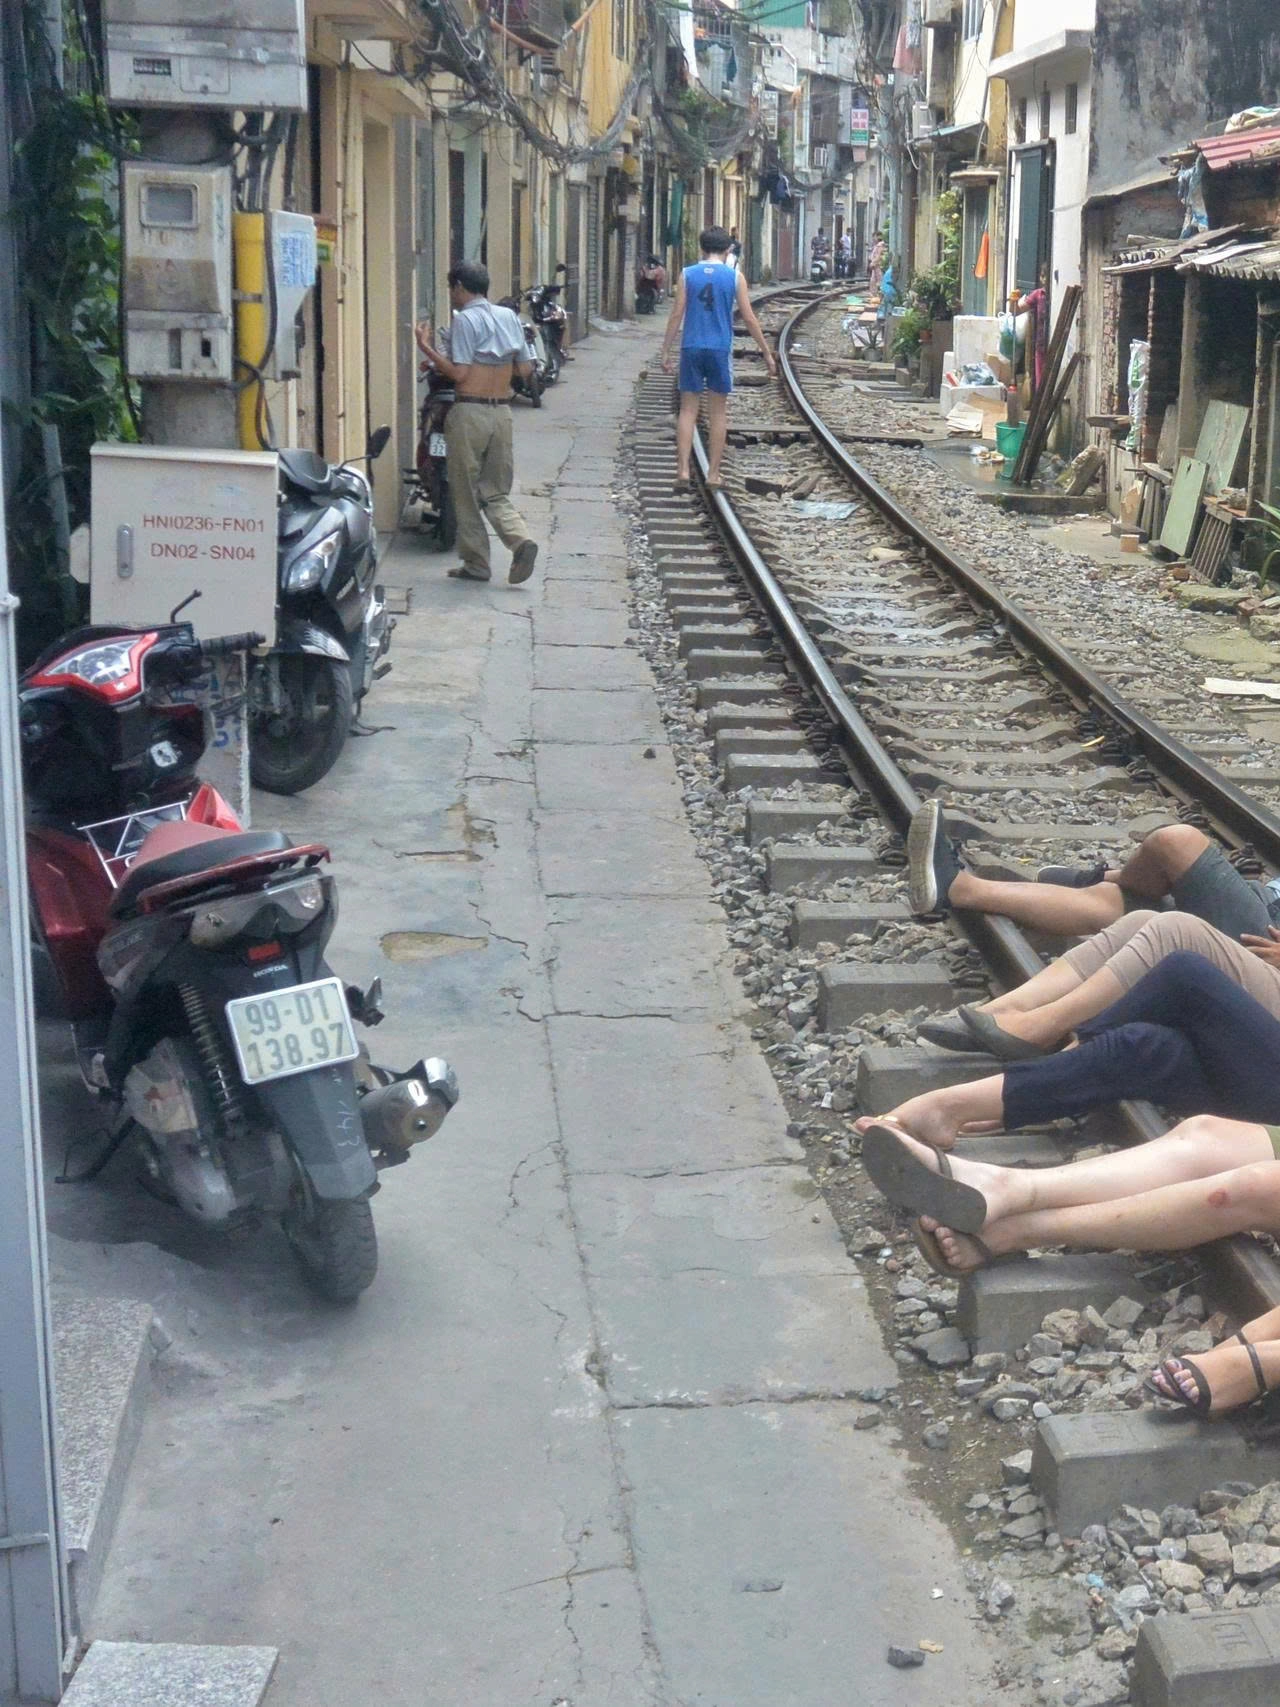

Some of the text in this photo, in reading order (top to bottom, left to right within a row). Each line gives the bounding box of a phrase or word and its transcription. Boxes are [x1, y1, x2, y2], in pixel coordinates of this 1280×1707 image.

[698, 283, 715, 311] 4
[253, 964, 288, 978] HONDA
[245, 988, 329, 1036] 99-D1
[247, 1022, 344, 1075] 138.97
